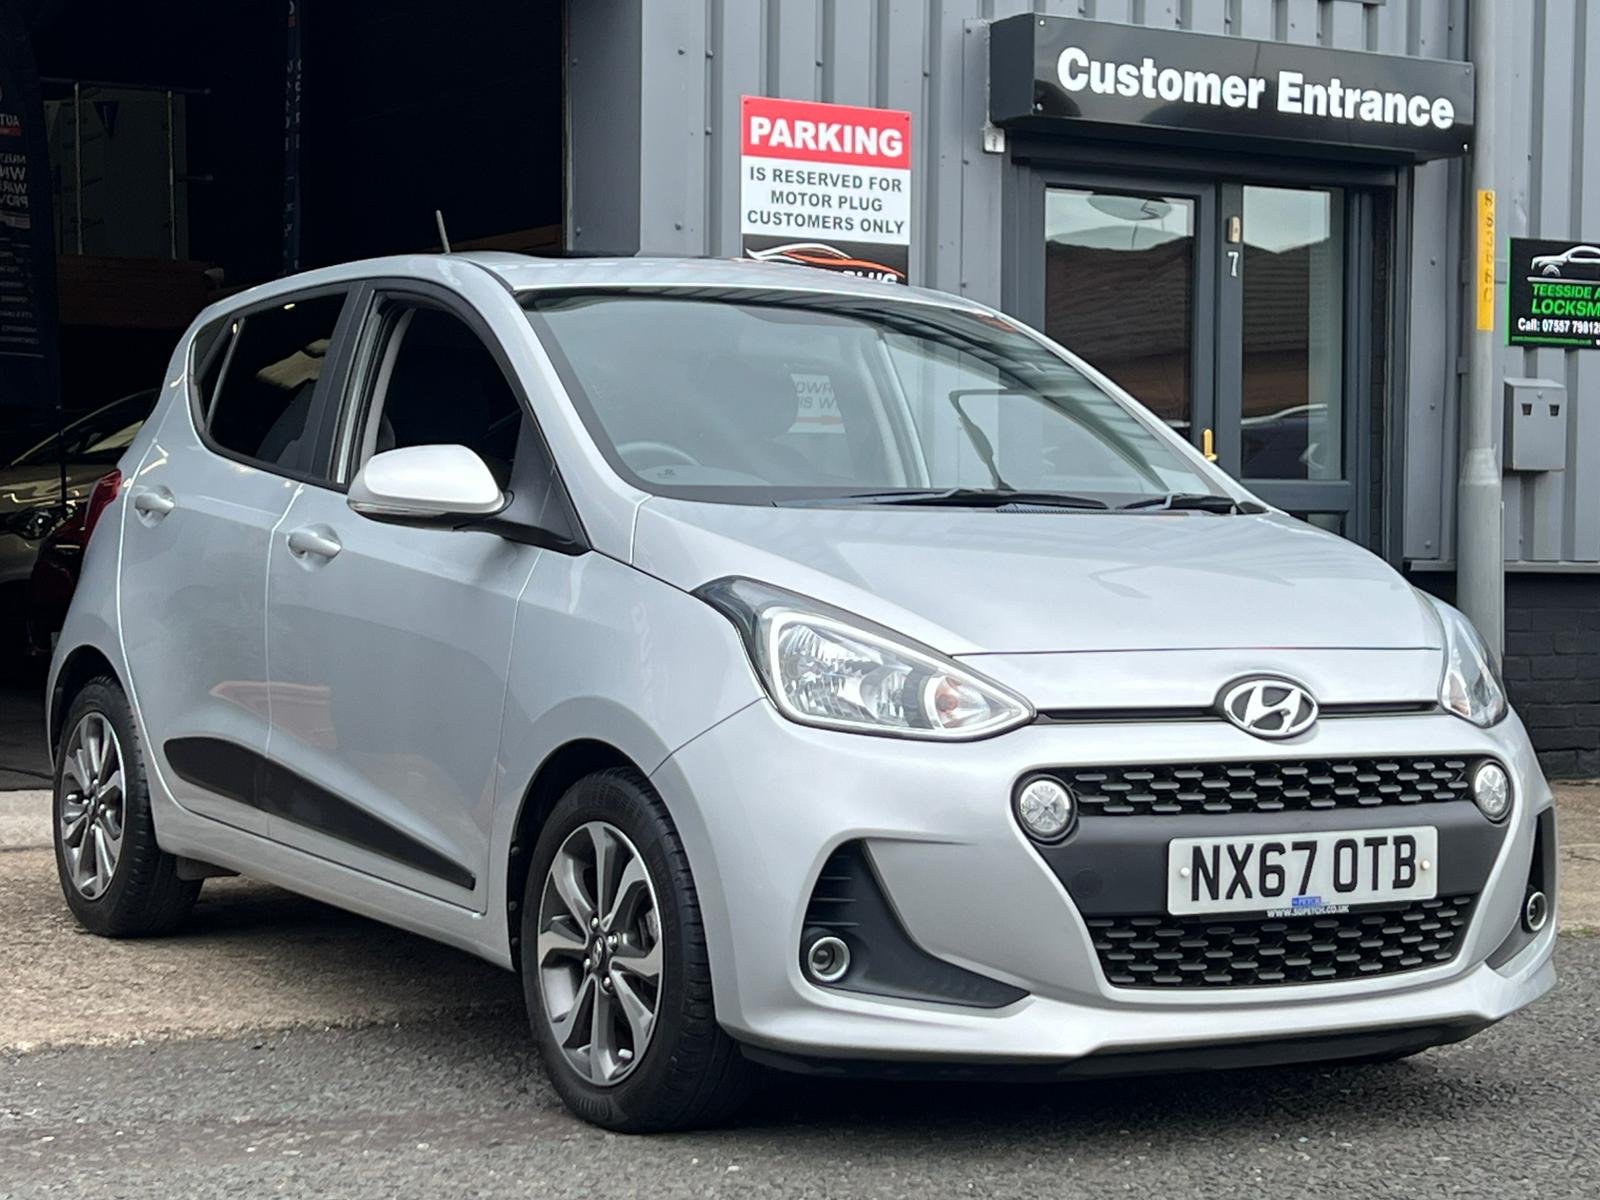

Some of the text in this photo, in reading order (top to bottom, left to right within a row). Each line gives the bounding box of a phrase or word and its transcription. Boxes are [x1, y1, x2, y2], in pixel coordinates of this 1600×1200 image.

[1057, 46, 1455, 129] Customer Entrance
[750, 116, 903, 157] PARKING
[750, 166, 902, 192] IS RESERVED FOR
[771, 190, 883, 212] MOTOR PLUG
[747, 210, 905, 234] CUSTOMERS ONLY
[1227, 251, 1239, 277] 7
[1532, 284, 1592, 299] TEESSIDE
[1518, 317, 1540, 332] Call:
[1191, 834, 1417, 902] NX67 OTB
